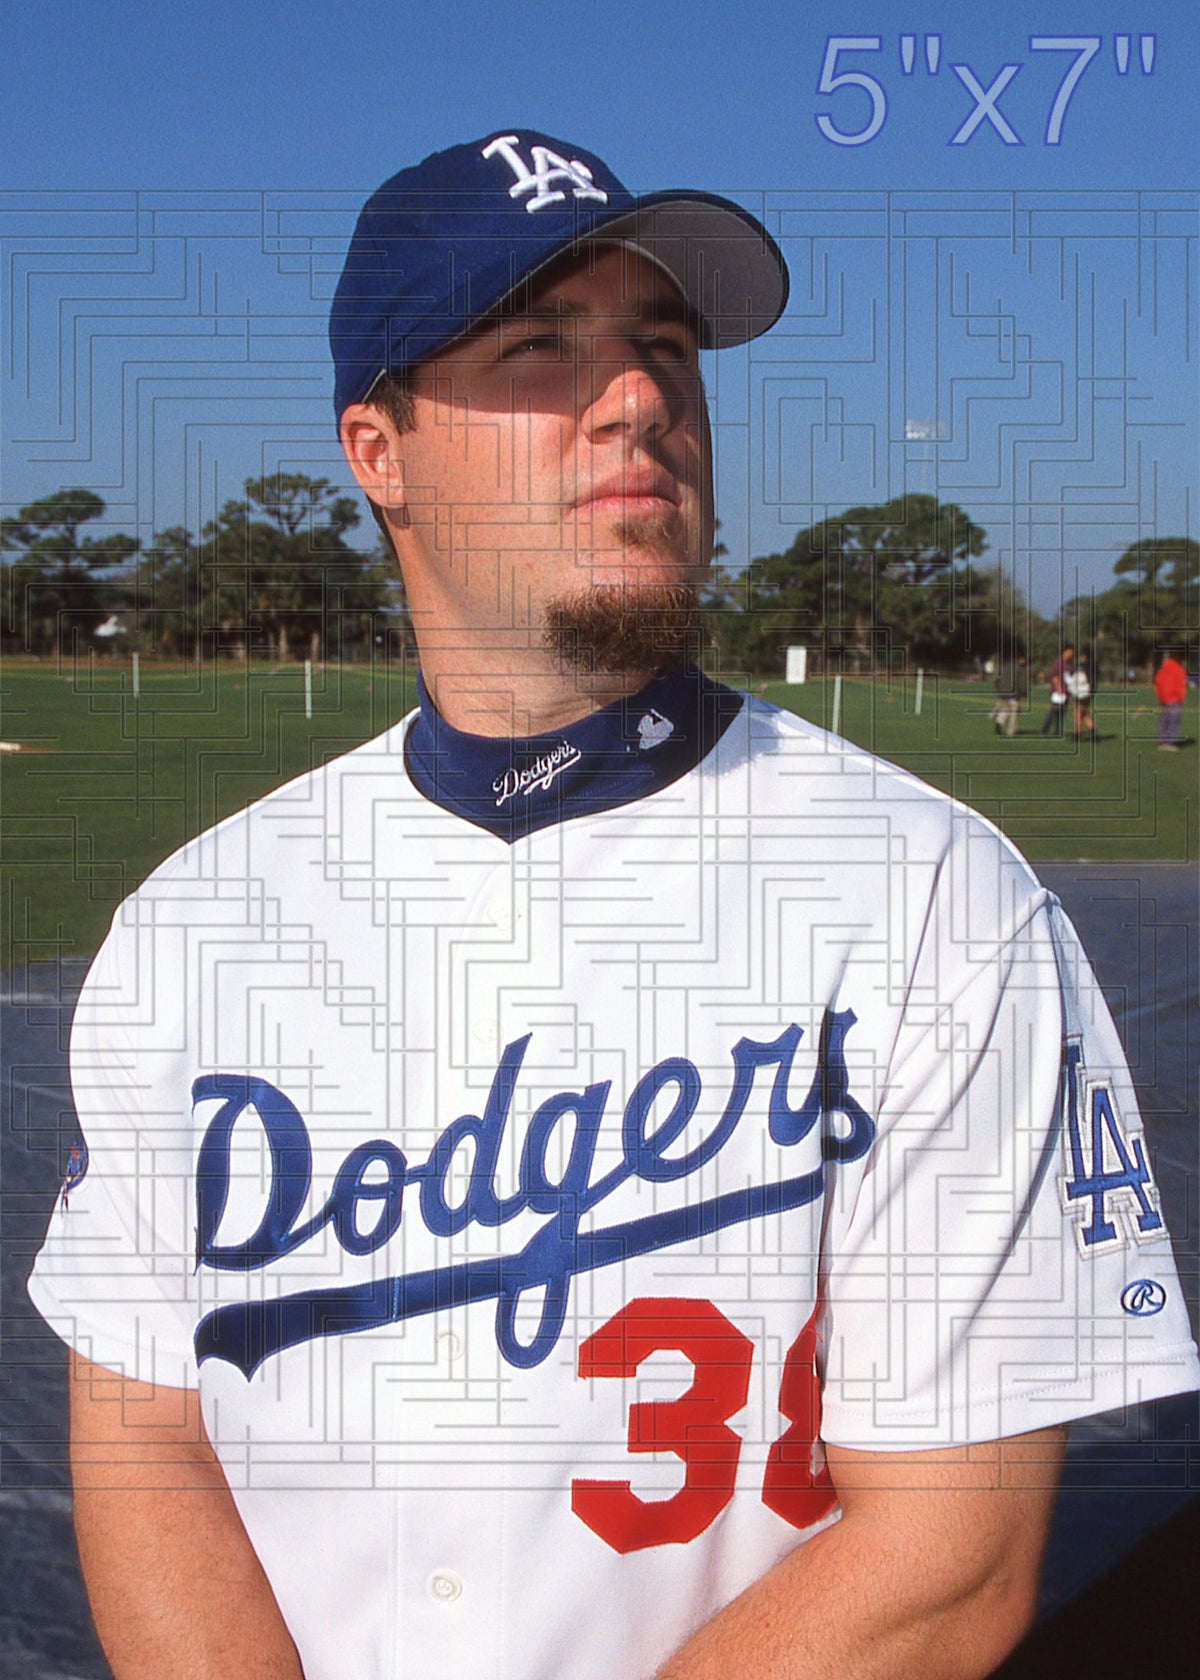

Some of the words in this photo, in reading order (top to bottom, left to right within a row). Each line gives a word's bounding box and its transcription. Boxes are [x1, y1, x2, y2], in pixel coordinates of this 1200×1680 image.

[481, 135, 608, 214] LA
[492, 740, 581, 807] Dodgers
[192, 1007, 876, 1372] Dodgers
[1061, 1040, 1166, 1252] LA
